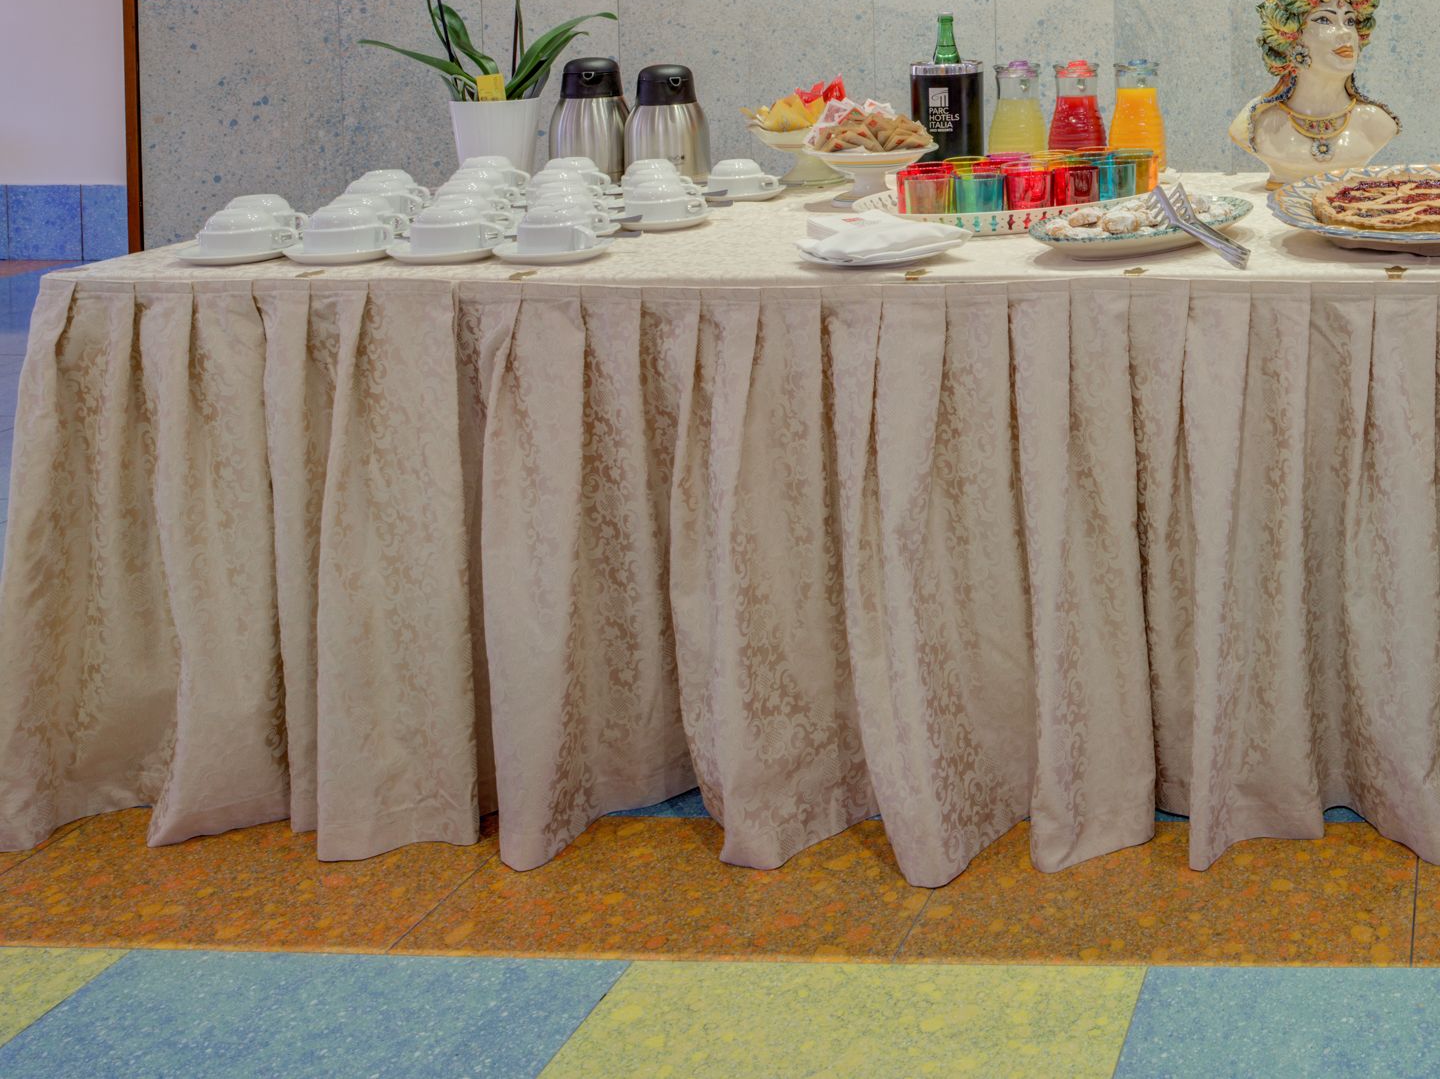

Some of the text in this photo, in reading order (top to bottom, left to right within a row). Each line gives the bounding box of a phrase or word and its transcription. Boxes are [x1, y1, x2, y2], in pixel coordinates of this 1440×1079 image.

[929, 107, 949, 115] PARC
[929, 113, 960, 122] HOTELS
[929, 121, 953, 129] ITALIA
